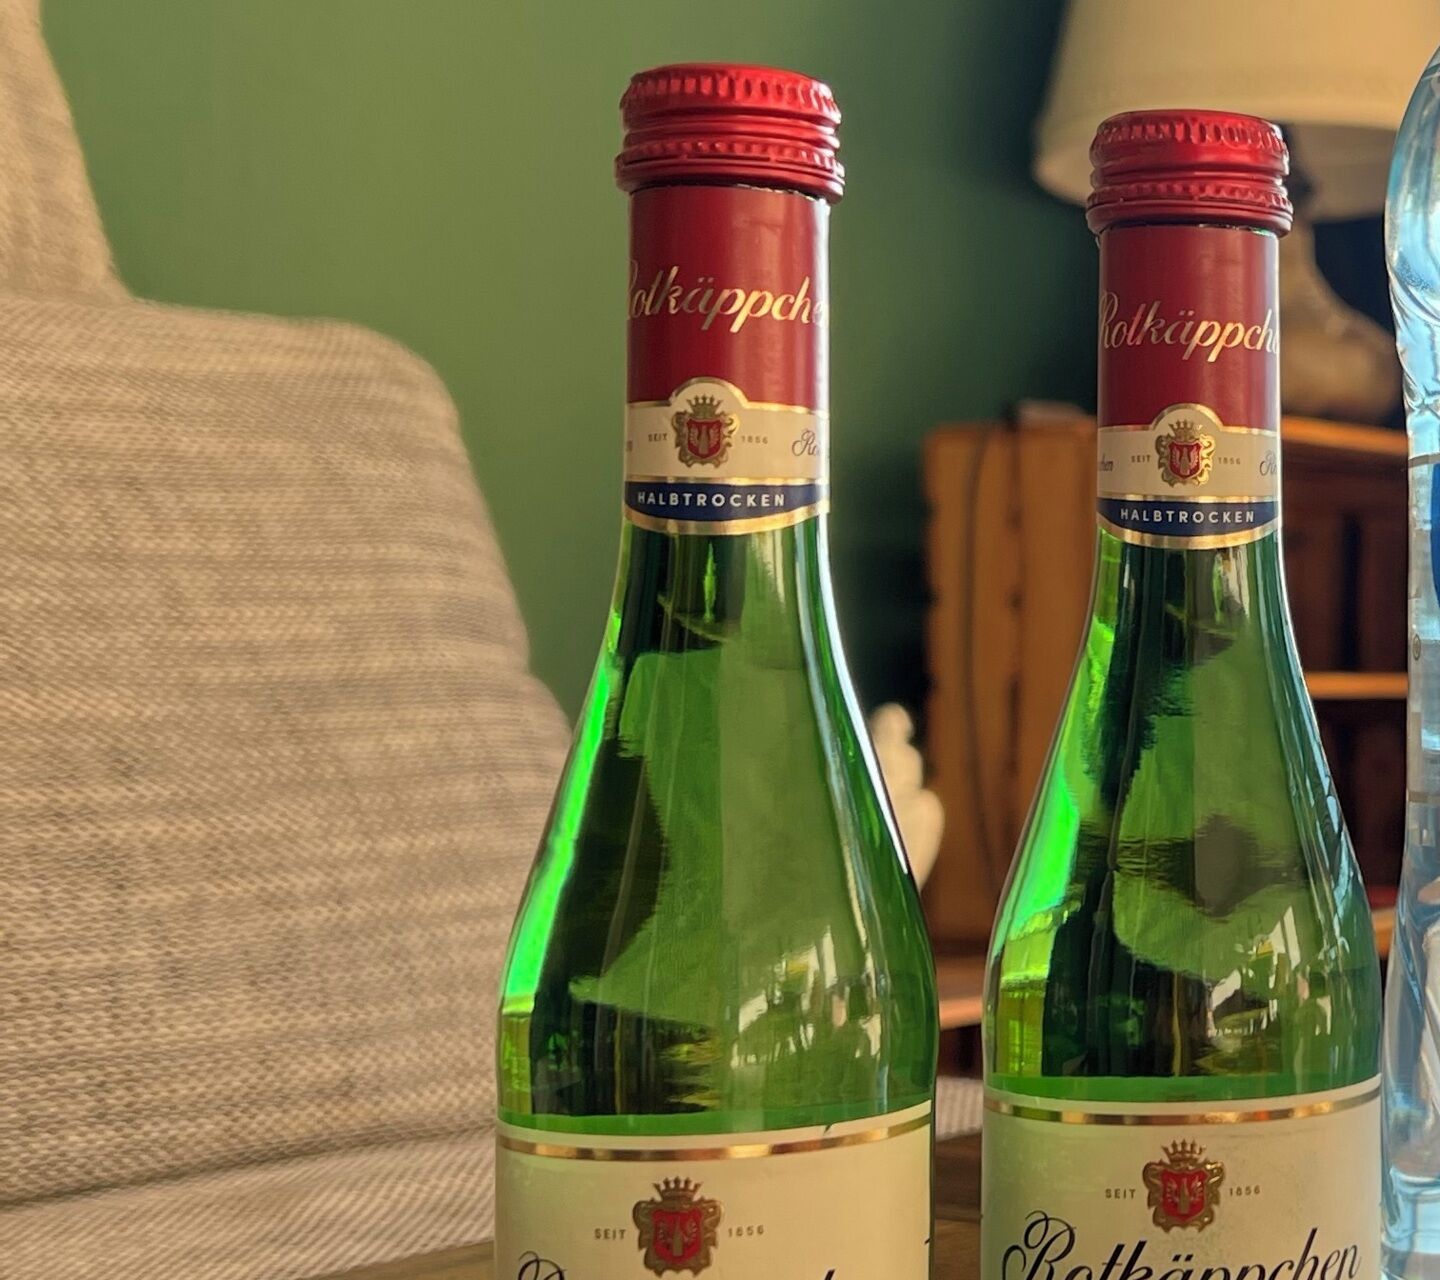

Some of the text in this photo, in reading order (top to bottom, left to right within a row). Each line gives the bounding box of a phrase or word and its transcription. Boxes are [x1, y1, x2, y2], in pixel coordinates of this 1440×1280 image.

[1131, 455, 1151, 464] SEIT
[637, 490, 785, 507] HALBTROCKEN
[1120, 508, 1254, 523] HALBTROCKEN
[1105, 1188, 1136, 1200] SEIT
[594, 1227, 626, 1240] SEIT
